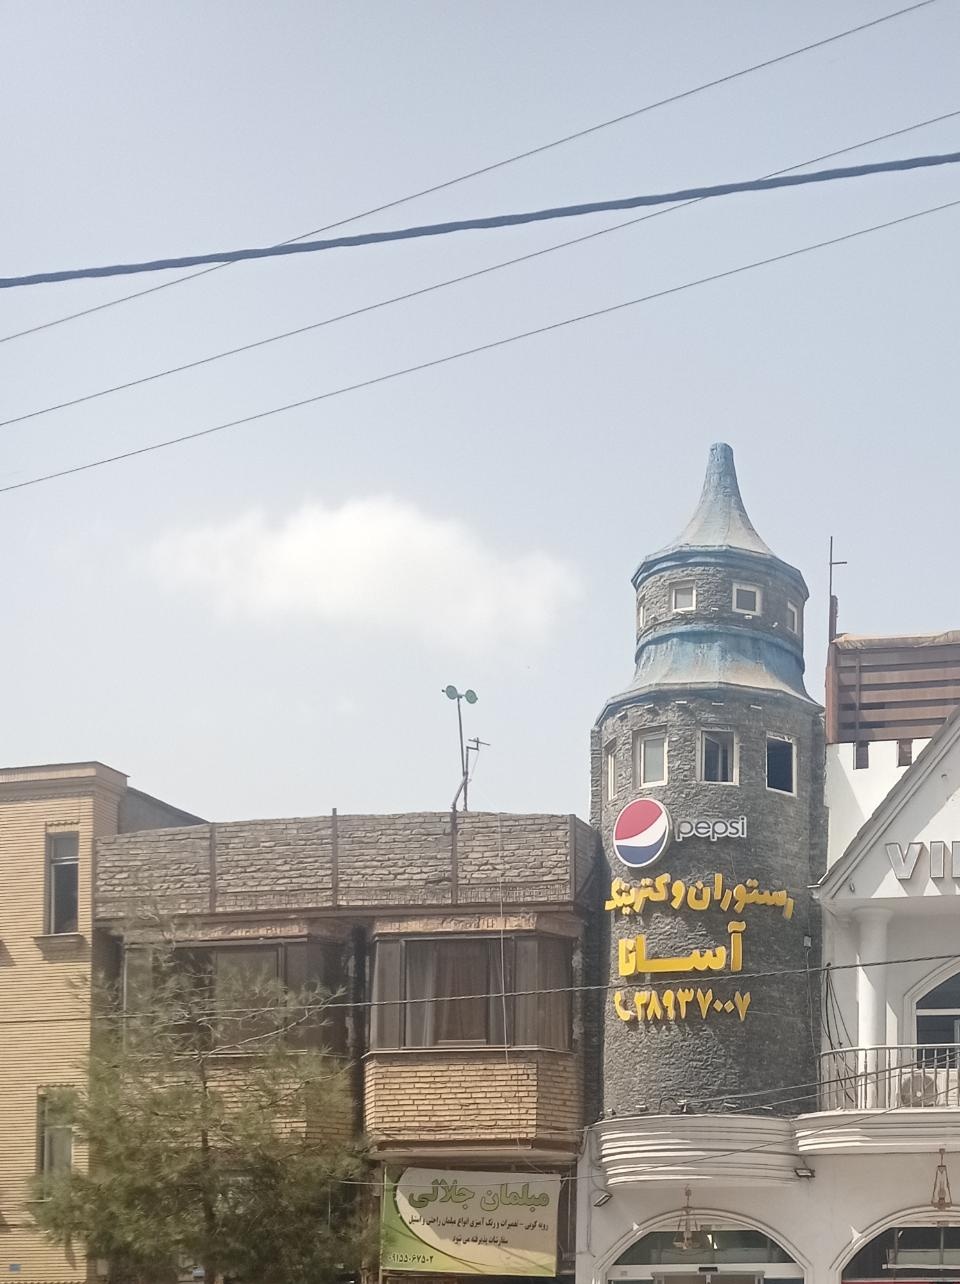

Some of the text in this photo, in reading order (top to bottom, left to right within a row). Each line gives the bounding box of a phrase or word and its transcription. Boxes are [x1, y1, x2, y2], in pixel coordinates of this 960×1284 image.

[676, 815, 748, 842] pepsi
[604, 872, 795, 921] رستوران و کترینگ
[617, 921, 747, 977] آسانا
[633, 987, 751, 1022] ۳۸۹۳۷۰۰۷
[408, 1178, 550, 1212] مبلمان جلالی
